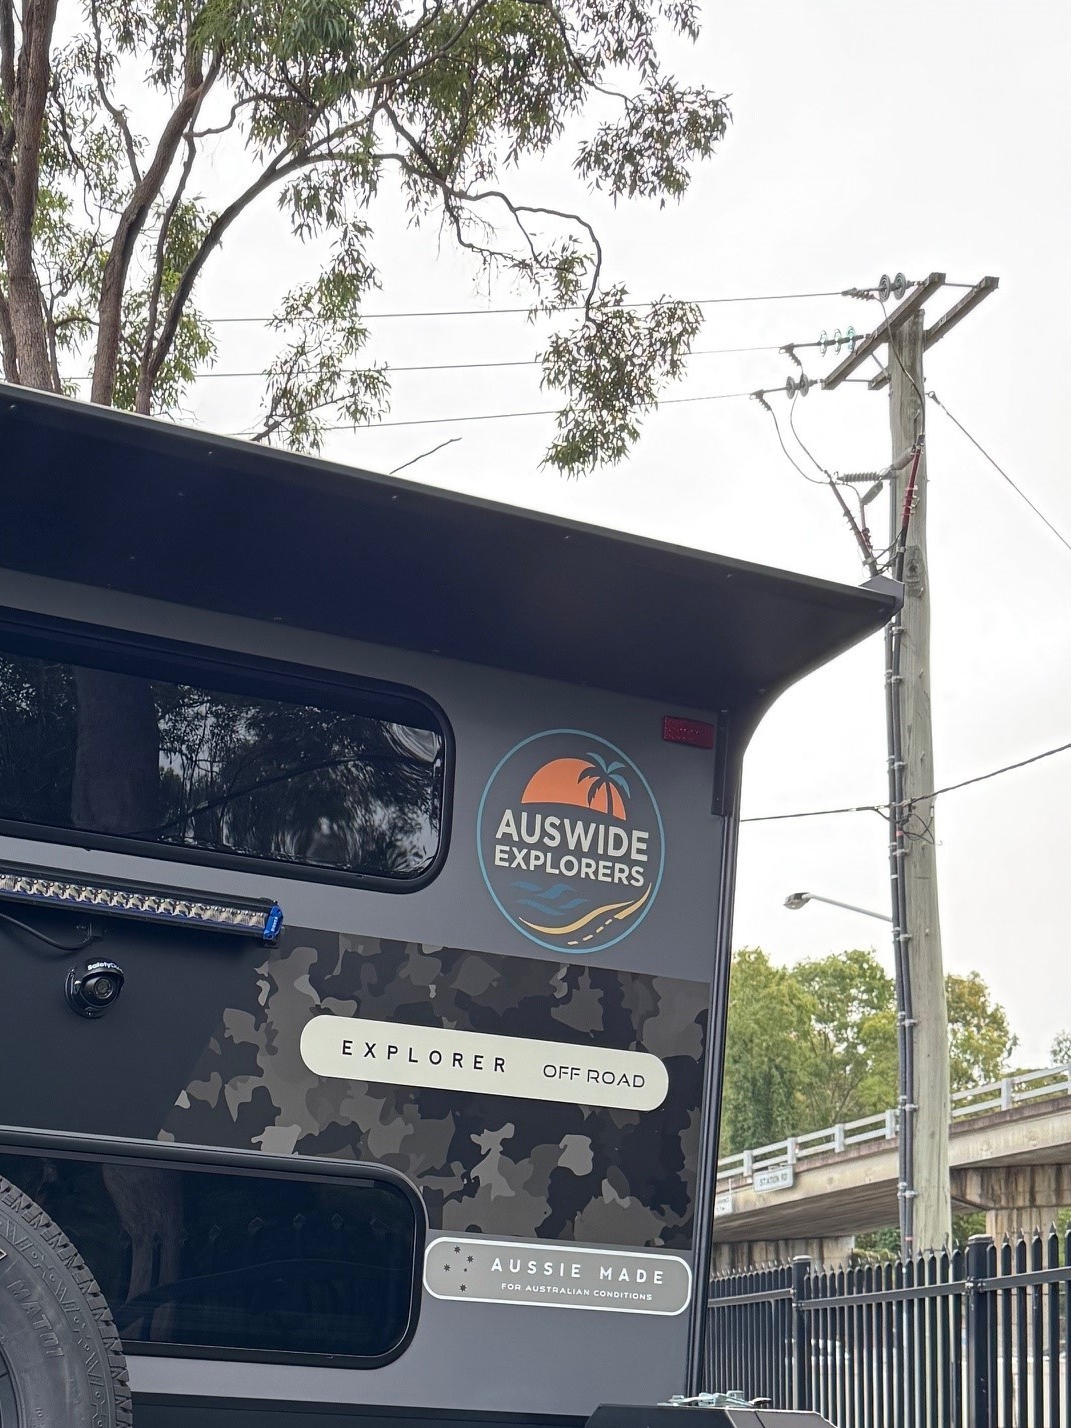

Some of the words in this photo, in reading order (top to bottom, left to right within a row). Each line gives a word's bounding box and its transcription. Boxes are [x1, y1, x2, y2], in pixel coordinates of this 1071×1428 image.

[495, 809, 649, 861] AUSWIDE
[494, 845, 645, 887] EXPLORERS
[342, 1040, 506, 1073] EXPLORER
[543, 1064, 581, 1081] OFF
[587, 1069, 646, 1089] ROAD
[490, 1257, 581, 1278] AUSSIE
[599, 1266, 664, 1285] MADE
[501, 1283, 521, 1291] FOR
[525, 1285, 590, 1296] AUSTRALIAN
[593, 1290, 652, 1301] CONDITIONS
